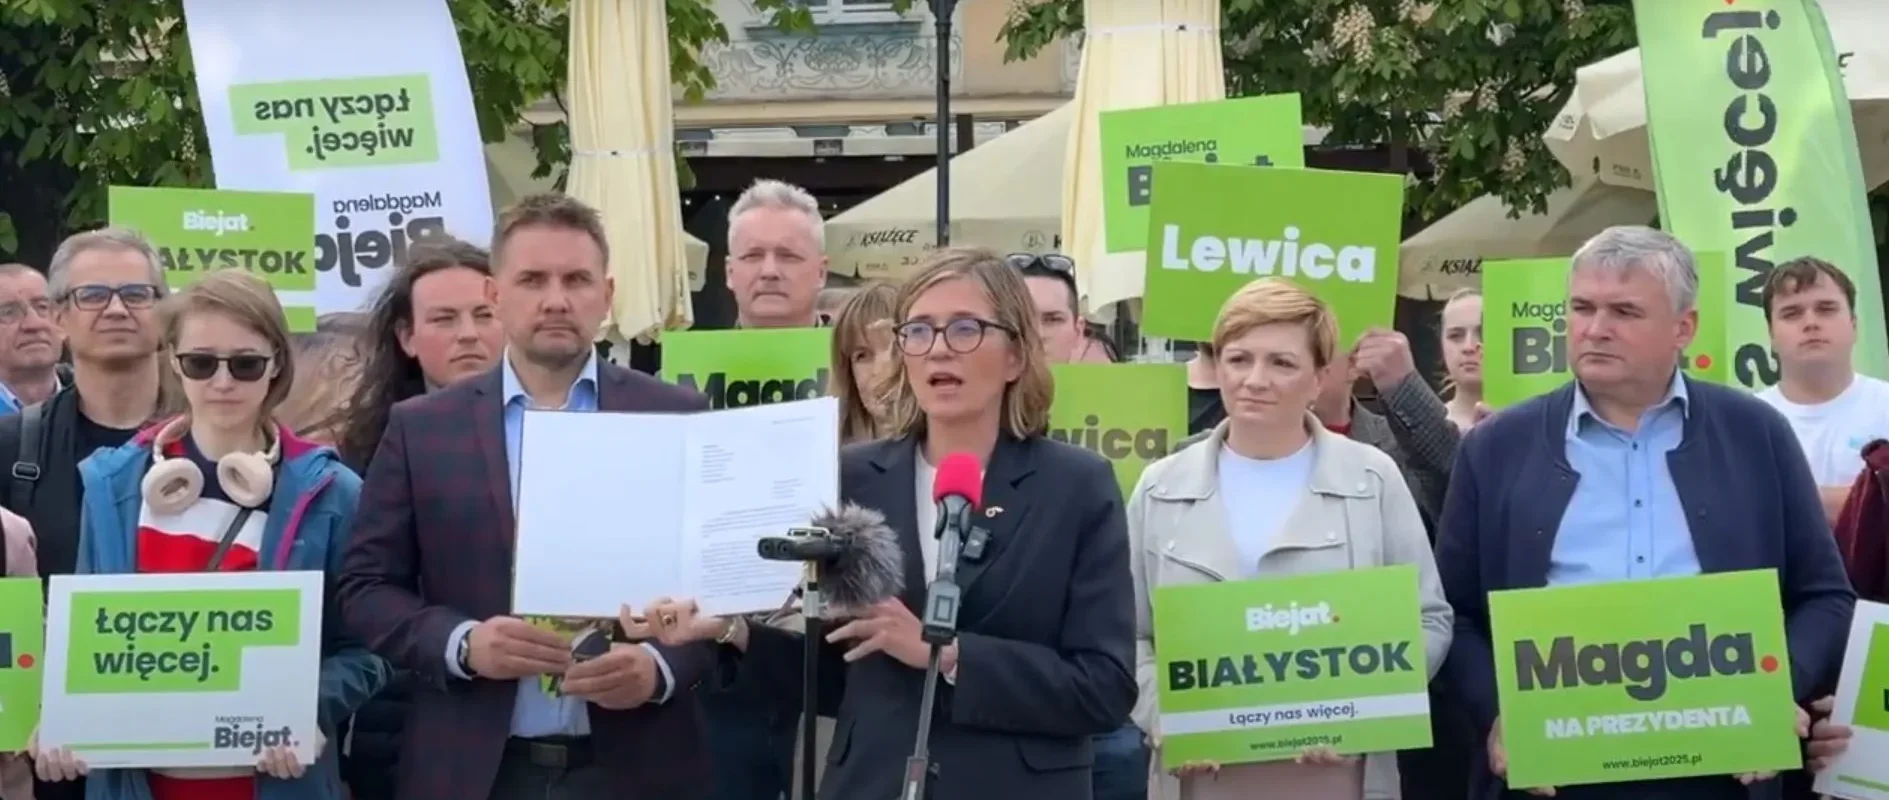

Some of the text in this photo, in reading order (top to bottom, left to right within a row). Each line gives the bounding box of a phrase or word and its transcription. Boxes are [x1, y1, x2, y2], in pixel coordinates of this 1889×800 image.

[1126, 138, 1218, 160] Magdalena
[183, 210, 255, 236] Biejat.
[158, 247, 307, 274] AŁYSTOK
[1161, 223, 1377, 283] Lewica
[1440, 256, 1483, 277] KSIĄŻ
[95, 607, 274, 642] Łączy nas
[1245, 600, 1341, 636] Biejat.
[93, 642, 220, 683] więcej.
[1168, 640, 1415, 692] BIAŁYSTOK
[1513, 623, 1779, 702] Magda.
[1229, 702, 1359, 727] Łączy nas więcej.
[1545, 704, 1752, 739] NA PREZYDENTA
[214, 723, 300, 756] Biejat.
